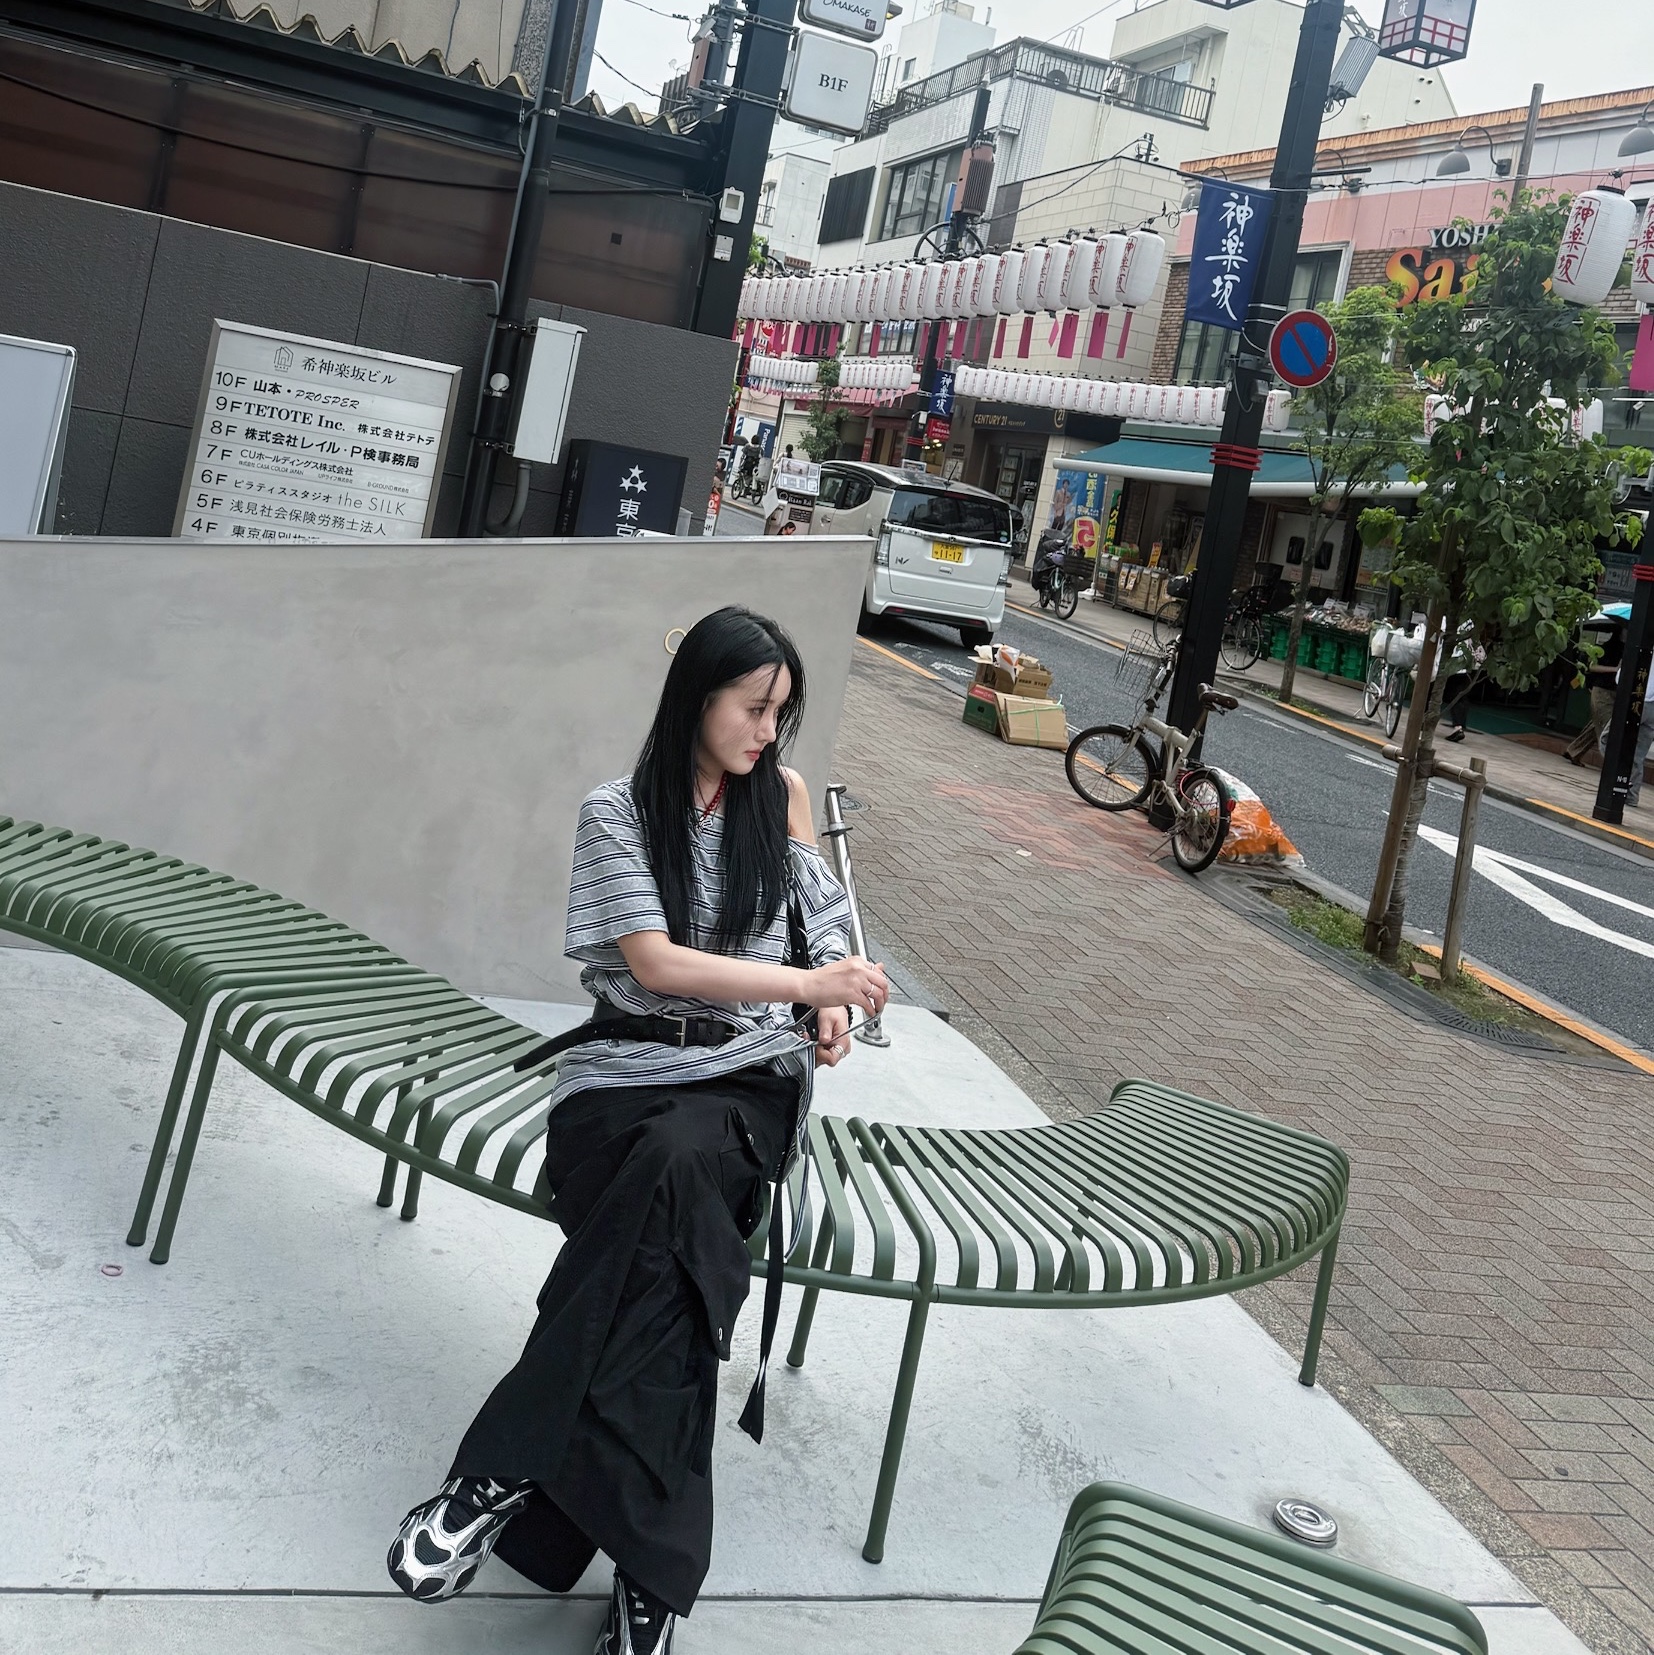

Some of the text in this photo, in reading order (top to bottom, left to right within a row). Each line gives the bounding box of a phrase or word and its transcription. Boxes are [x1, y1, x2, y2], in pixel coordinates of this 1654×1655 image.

[818, 73, 849, 92] B1F
[1204, 192, 1254, 321] 神楽坂
[1558, 200, 1594, 286] 神楽坂
[215, 371, 248, 388] 10F
[301, 355, 398, 384] 希神楽坂ビル
[210, 420, 238, 437] 8F
[215, 396, 435, 446] 9F TETOTE Inc. 株式会社テトテ
[974, 413, 1001, 425] CENTURY
[206, 443, 354, 476] 7F CUホールディングス株式会社
[200, 469, 406, 516] 6F ピラティススタジオ the SILK
[190, 518, 219, 534] 4F
[196, 493, 387, 536] 5F 浅見社会保険労務士法人
